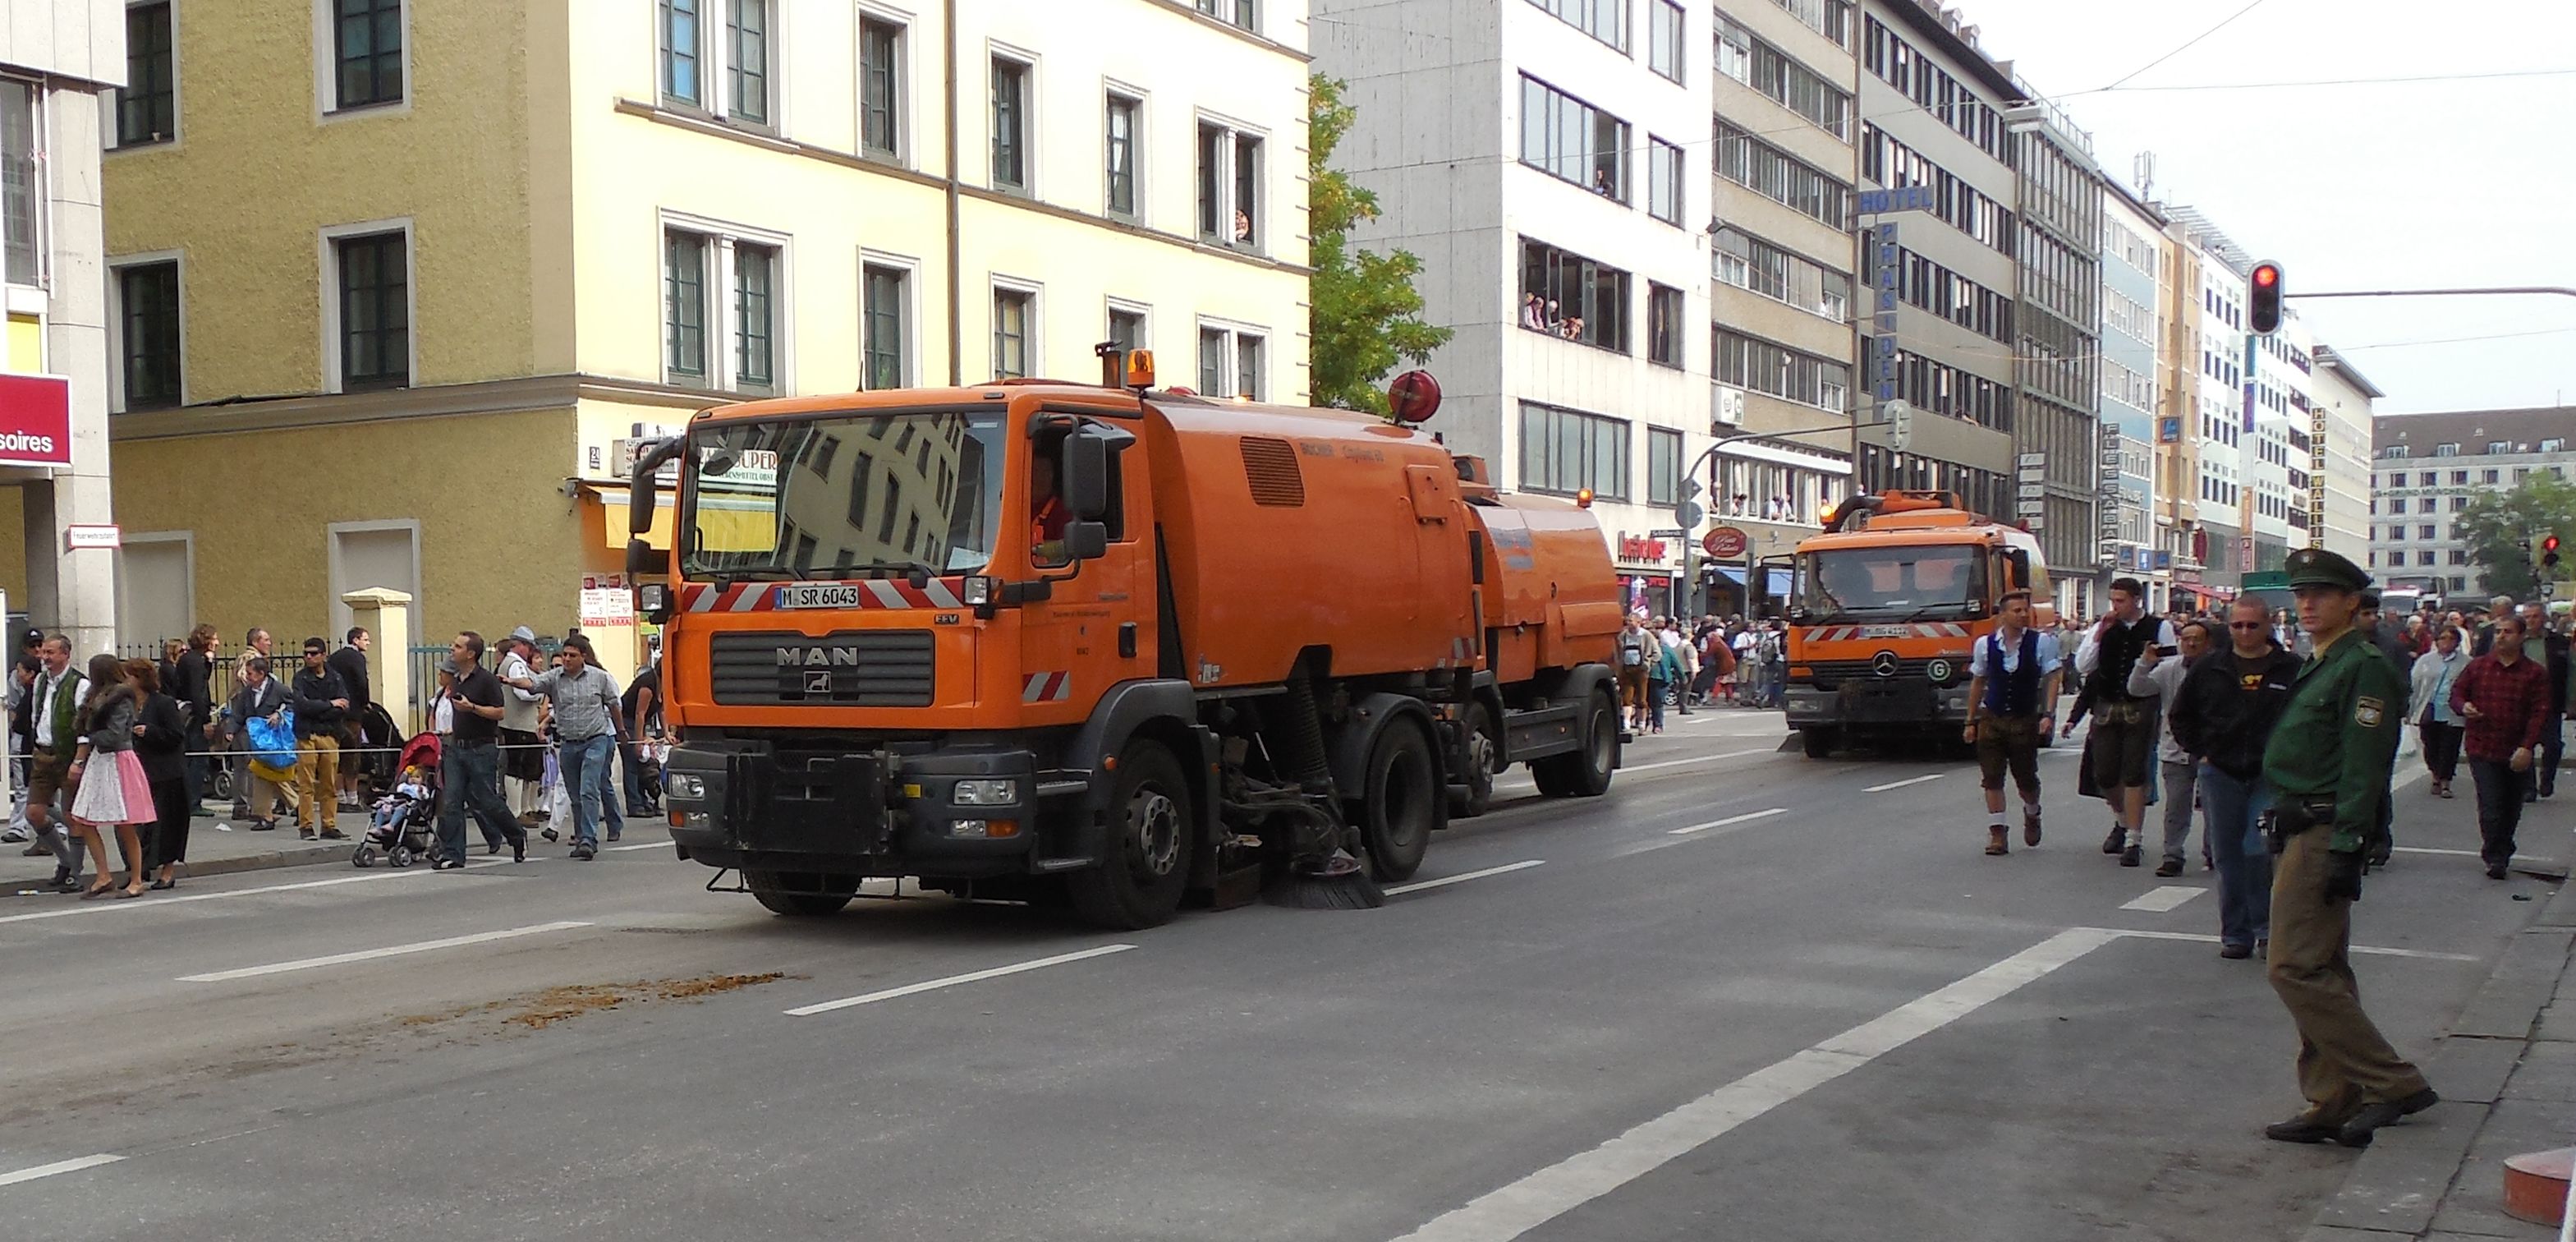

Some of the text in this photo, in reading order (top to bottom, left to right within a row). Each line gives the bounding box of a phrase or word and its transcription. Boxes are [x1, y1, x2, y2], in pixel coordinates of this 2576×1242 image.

[1860, 190, 1932, 211] HOTEL
[2313, 409, 2325, 470] HOTEL
[2104, 424, 2117, 568] FLESSABANK
[2312, 476, 2324, 550] WALLIS
[783, 588, 856, 605] M SR 6043
[935, 614, 957, 623] EEV
[776, 647, 858, 666] MAN
[1933, 663, 1945, 676] G
